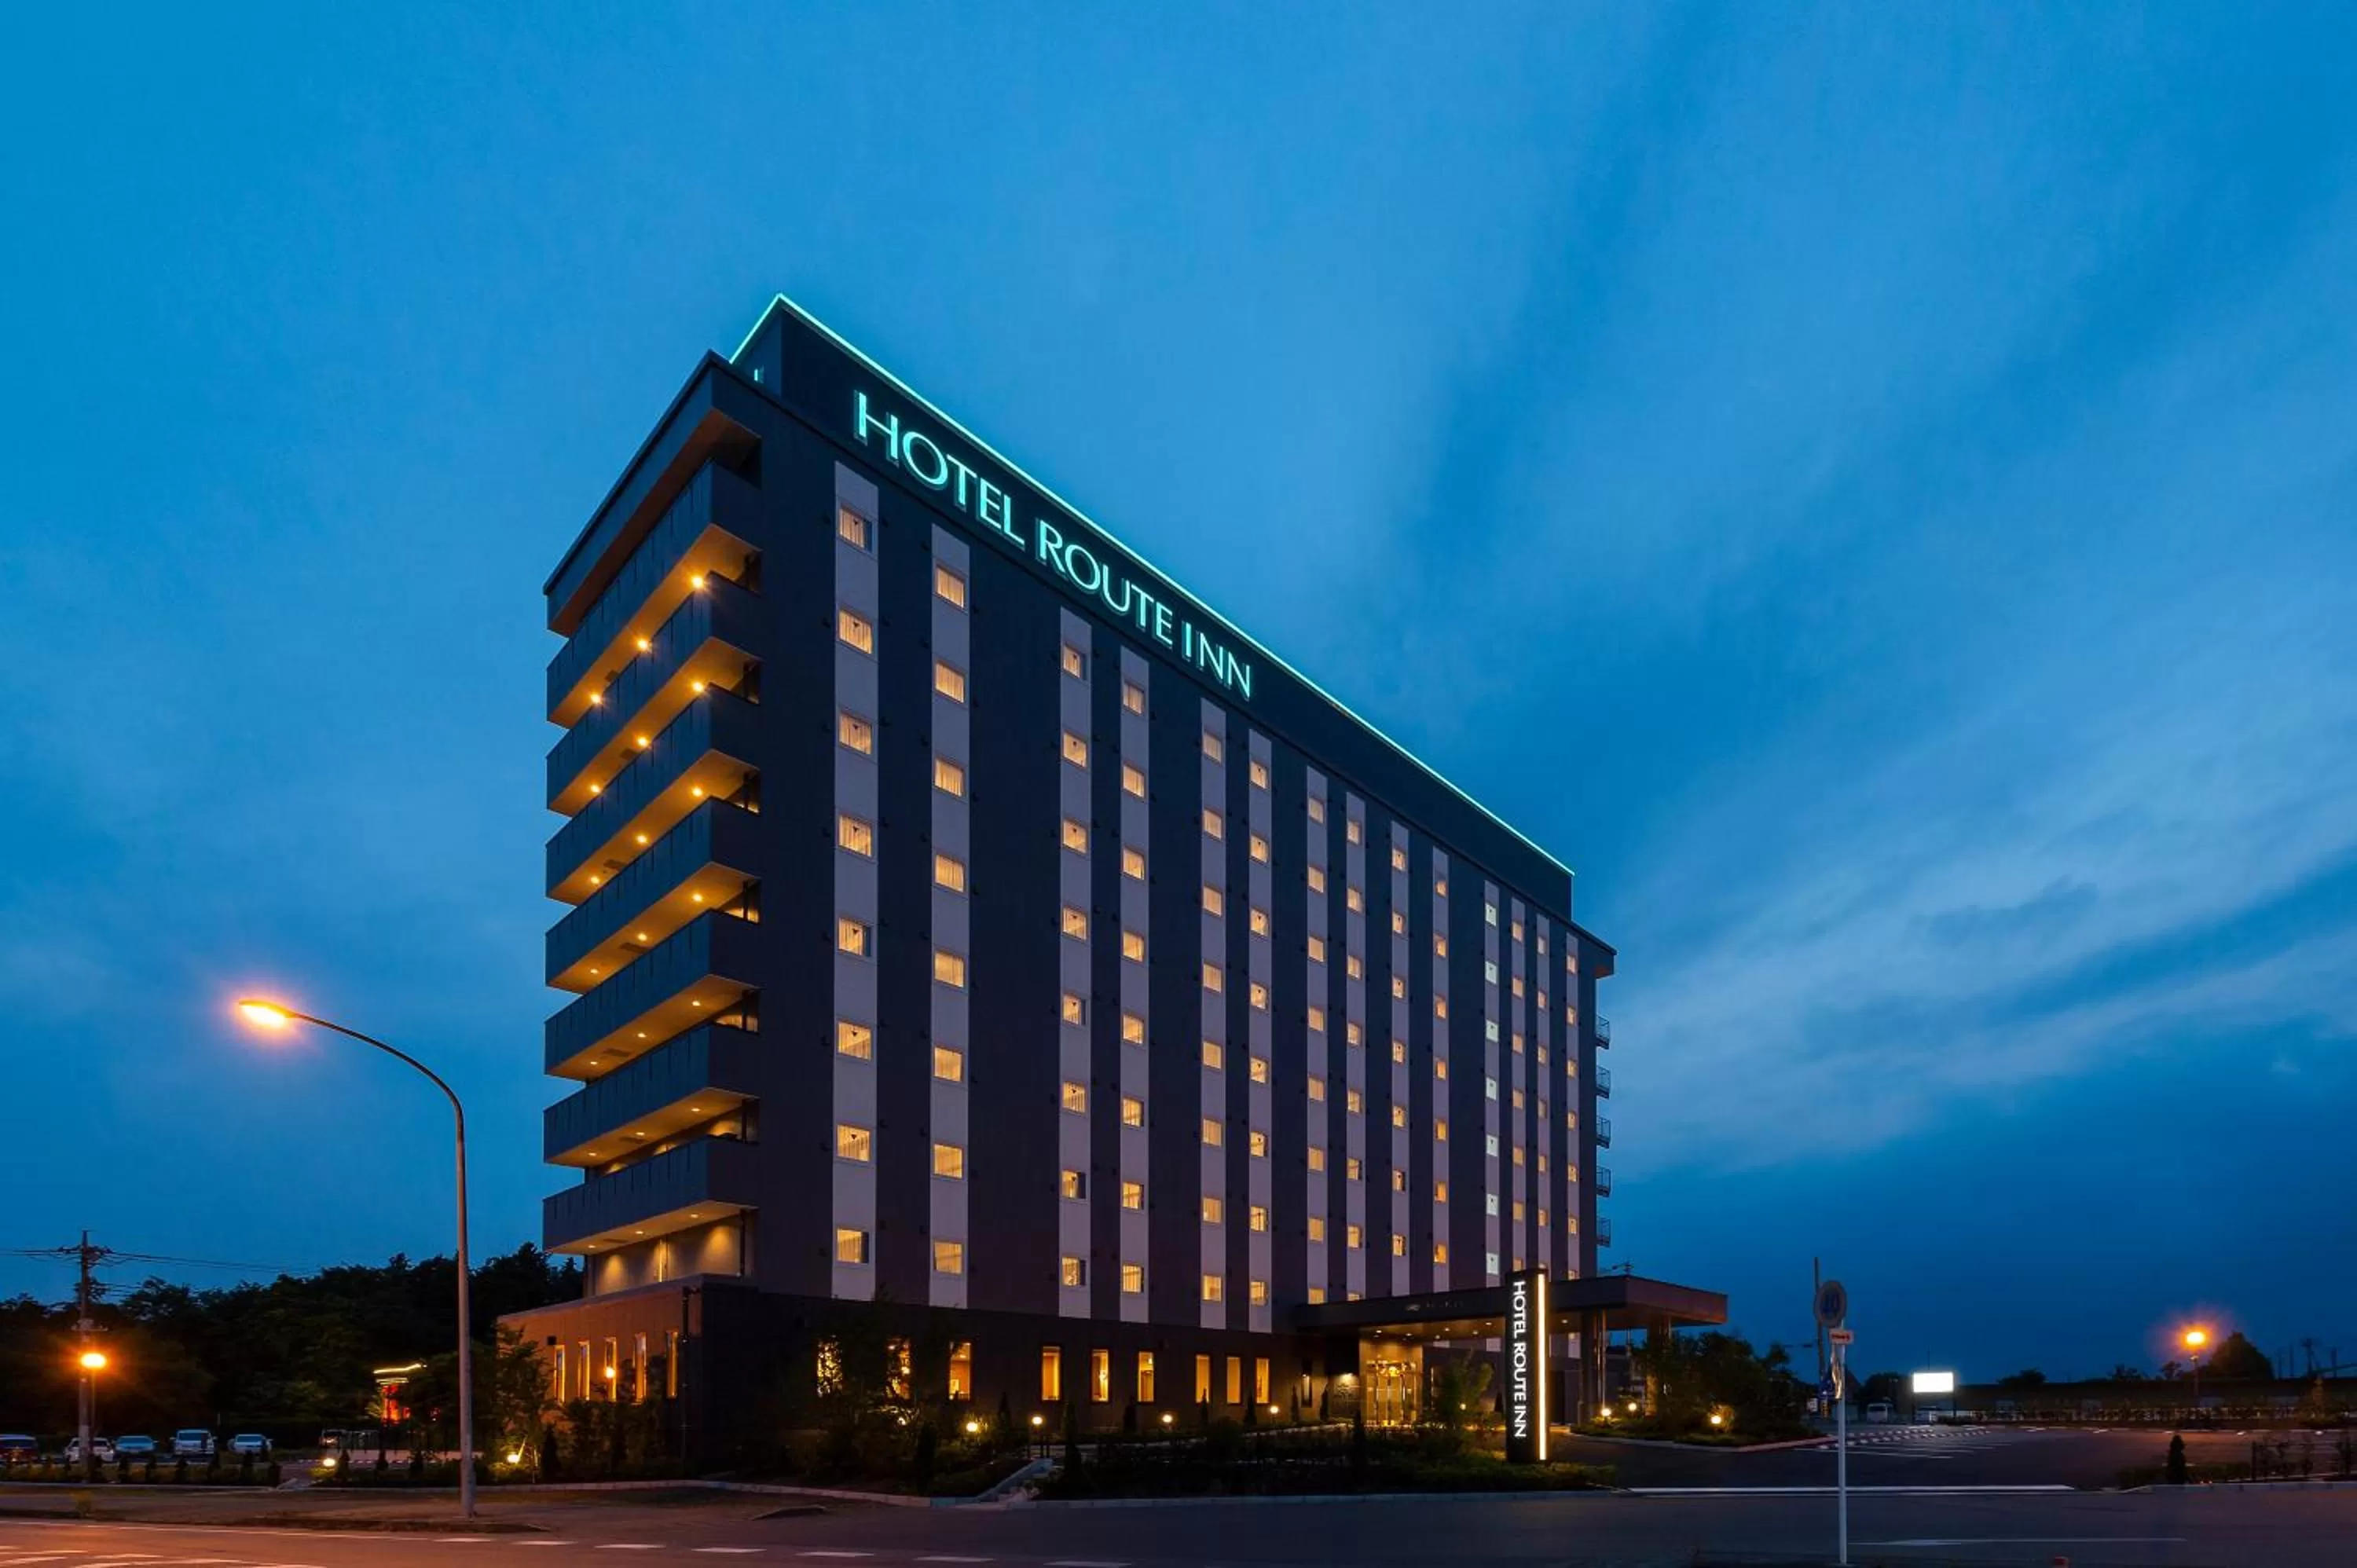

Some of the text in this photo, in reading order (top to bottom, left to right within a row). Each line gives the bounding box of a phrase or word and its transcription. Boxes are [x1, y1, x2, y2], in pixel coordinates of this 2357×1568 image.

[855, 390, 1251, 700] HOTEL ROUTE INN
[1512, 1280, 1527, 1438] HOTEL ROUTE INN
